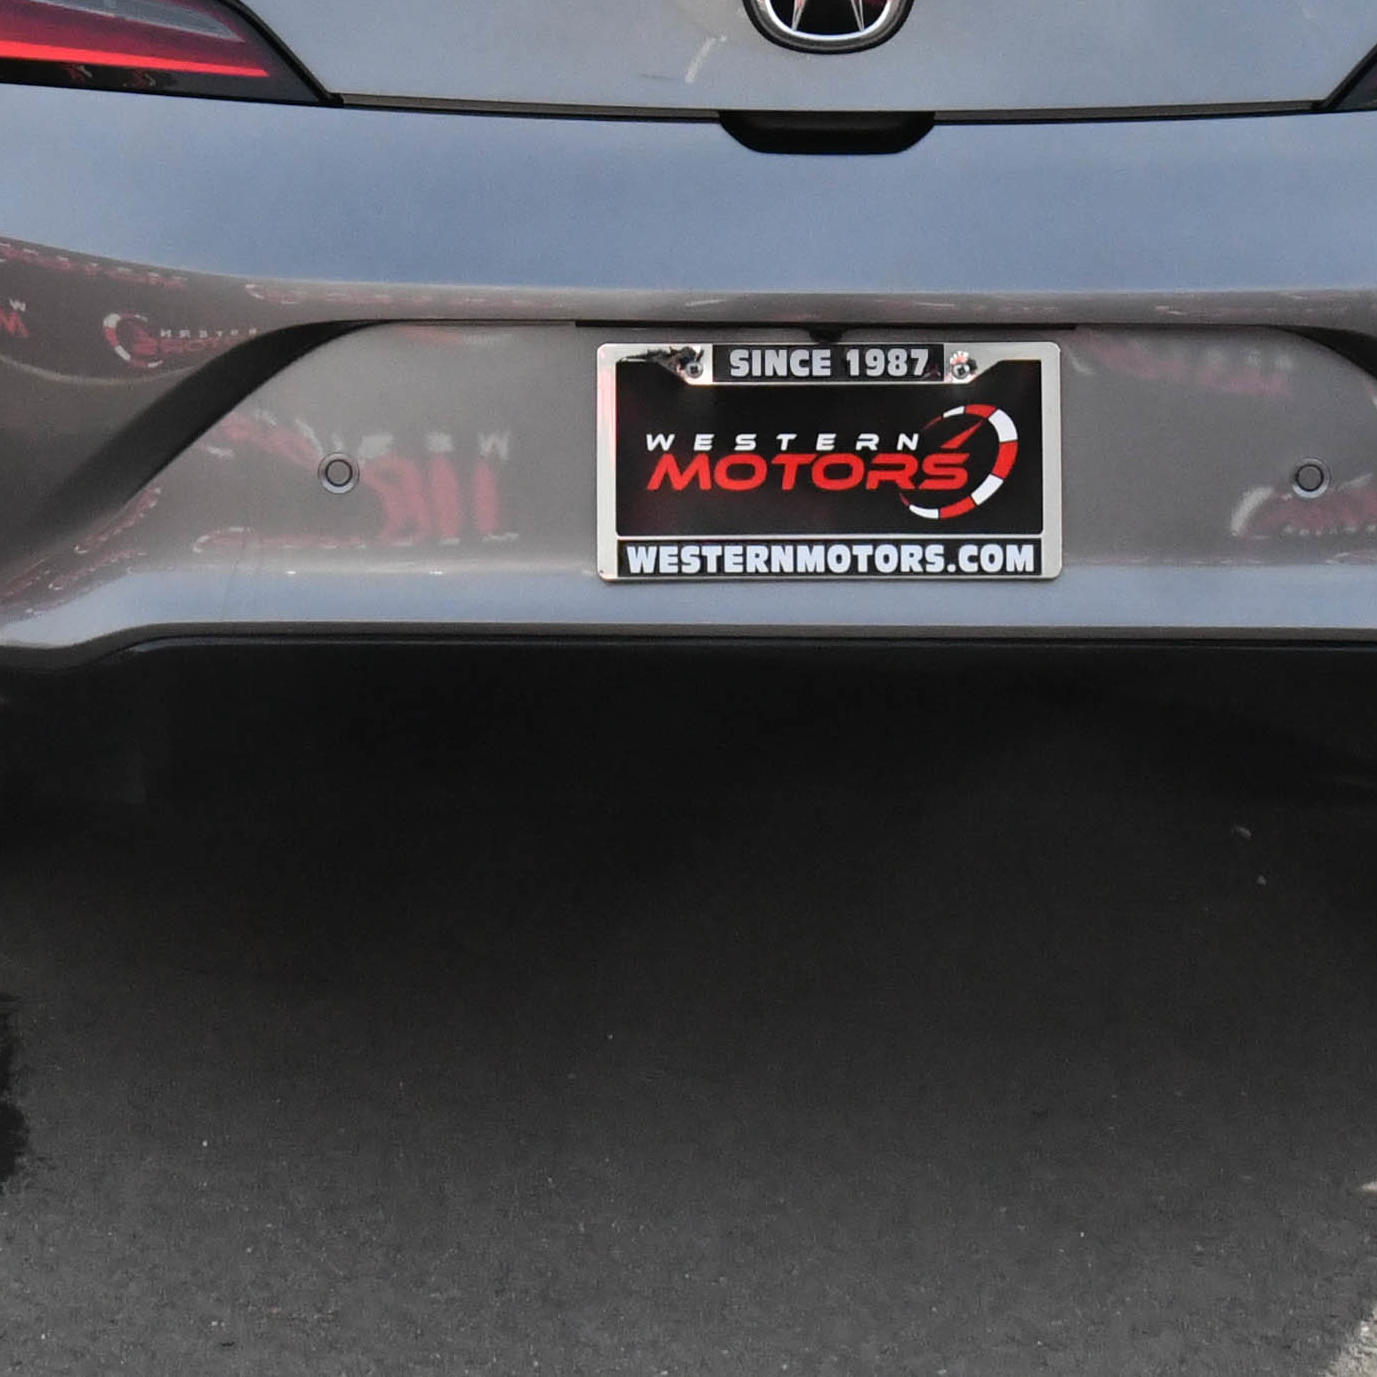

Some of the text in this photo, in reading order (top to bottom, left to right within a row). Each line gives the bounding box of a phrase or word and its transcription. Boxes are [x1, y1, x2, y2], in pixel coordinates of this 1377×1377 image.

[729, 348, 930, 378] SINCE 1987
[645, 433, 920, 452] WESTERN
[646, 453, 970, 491] MOTORS
[627, 543, 1035, 574] WESTERNMOTORS.COM
